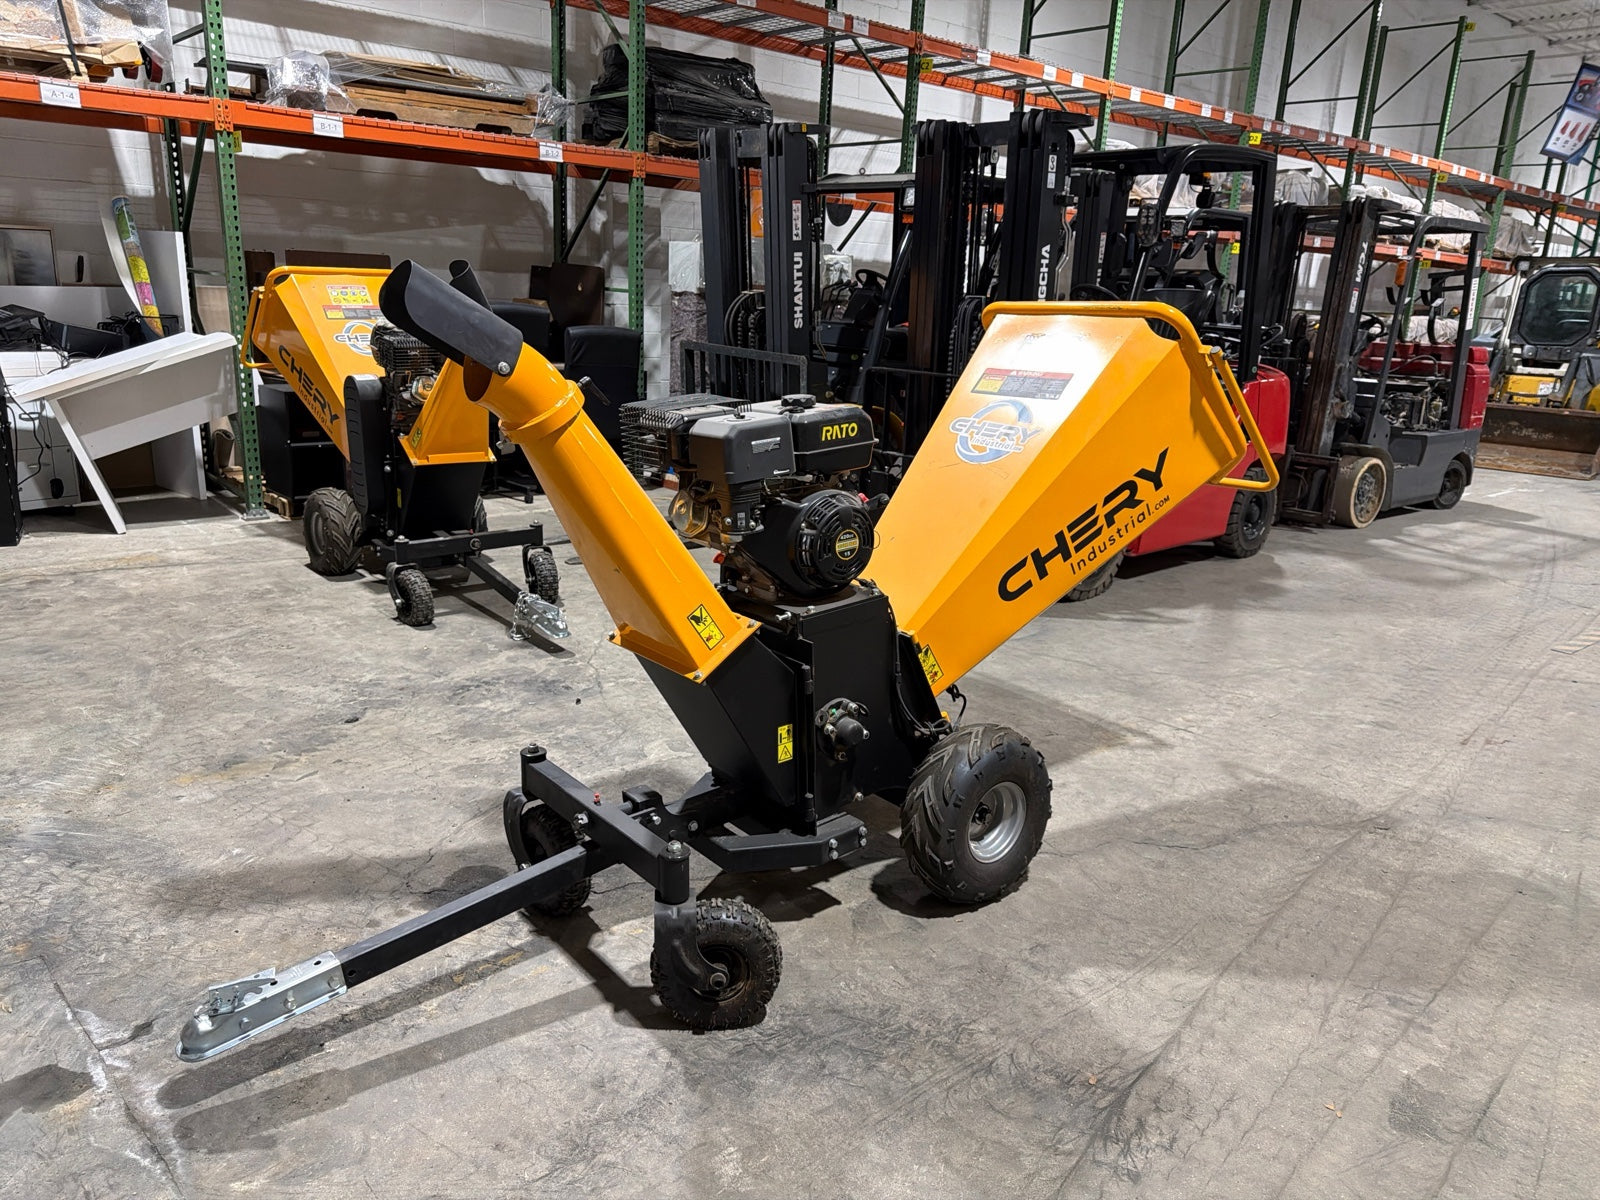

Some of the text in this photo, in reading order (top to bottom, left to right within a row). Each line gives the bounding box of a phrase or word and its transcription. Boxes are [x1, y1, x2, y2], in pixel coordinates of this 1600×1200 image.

[920, 61, 930, 71] C2
[51, 90, 75, 100] A-1-4
[320, 122, 337, 131] B-1-1
[1249, 135, 1259, 143] D2
[545, 149, 560, 157] B-1-2
[1355, 241, 1369, 283] TCM
[793, 251, 804, 329] SHANTUI
[334, 334, 370, 343] CHE
[278, 344, 341, 425] CHERY
[821, 422, 858, 442] RATO
[950, 418, 1044, 443] CHERY
[997, 446, 1170, 602] CHERY
